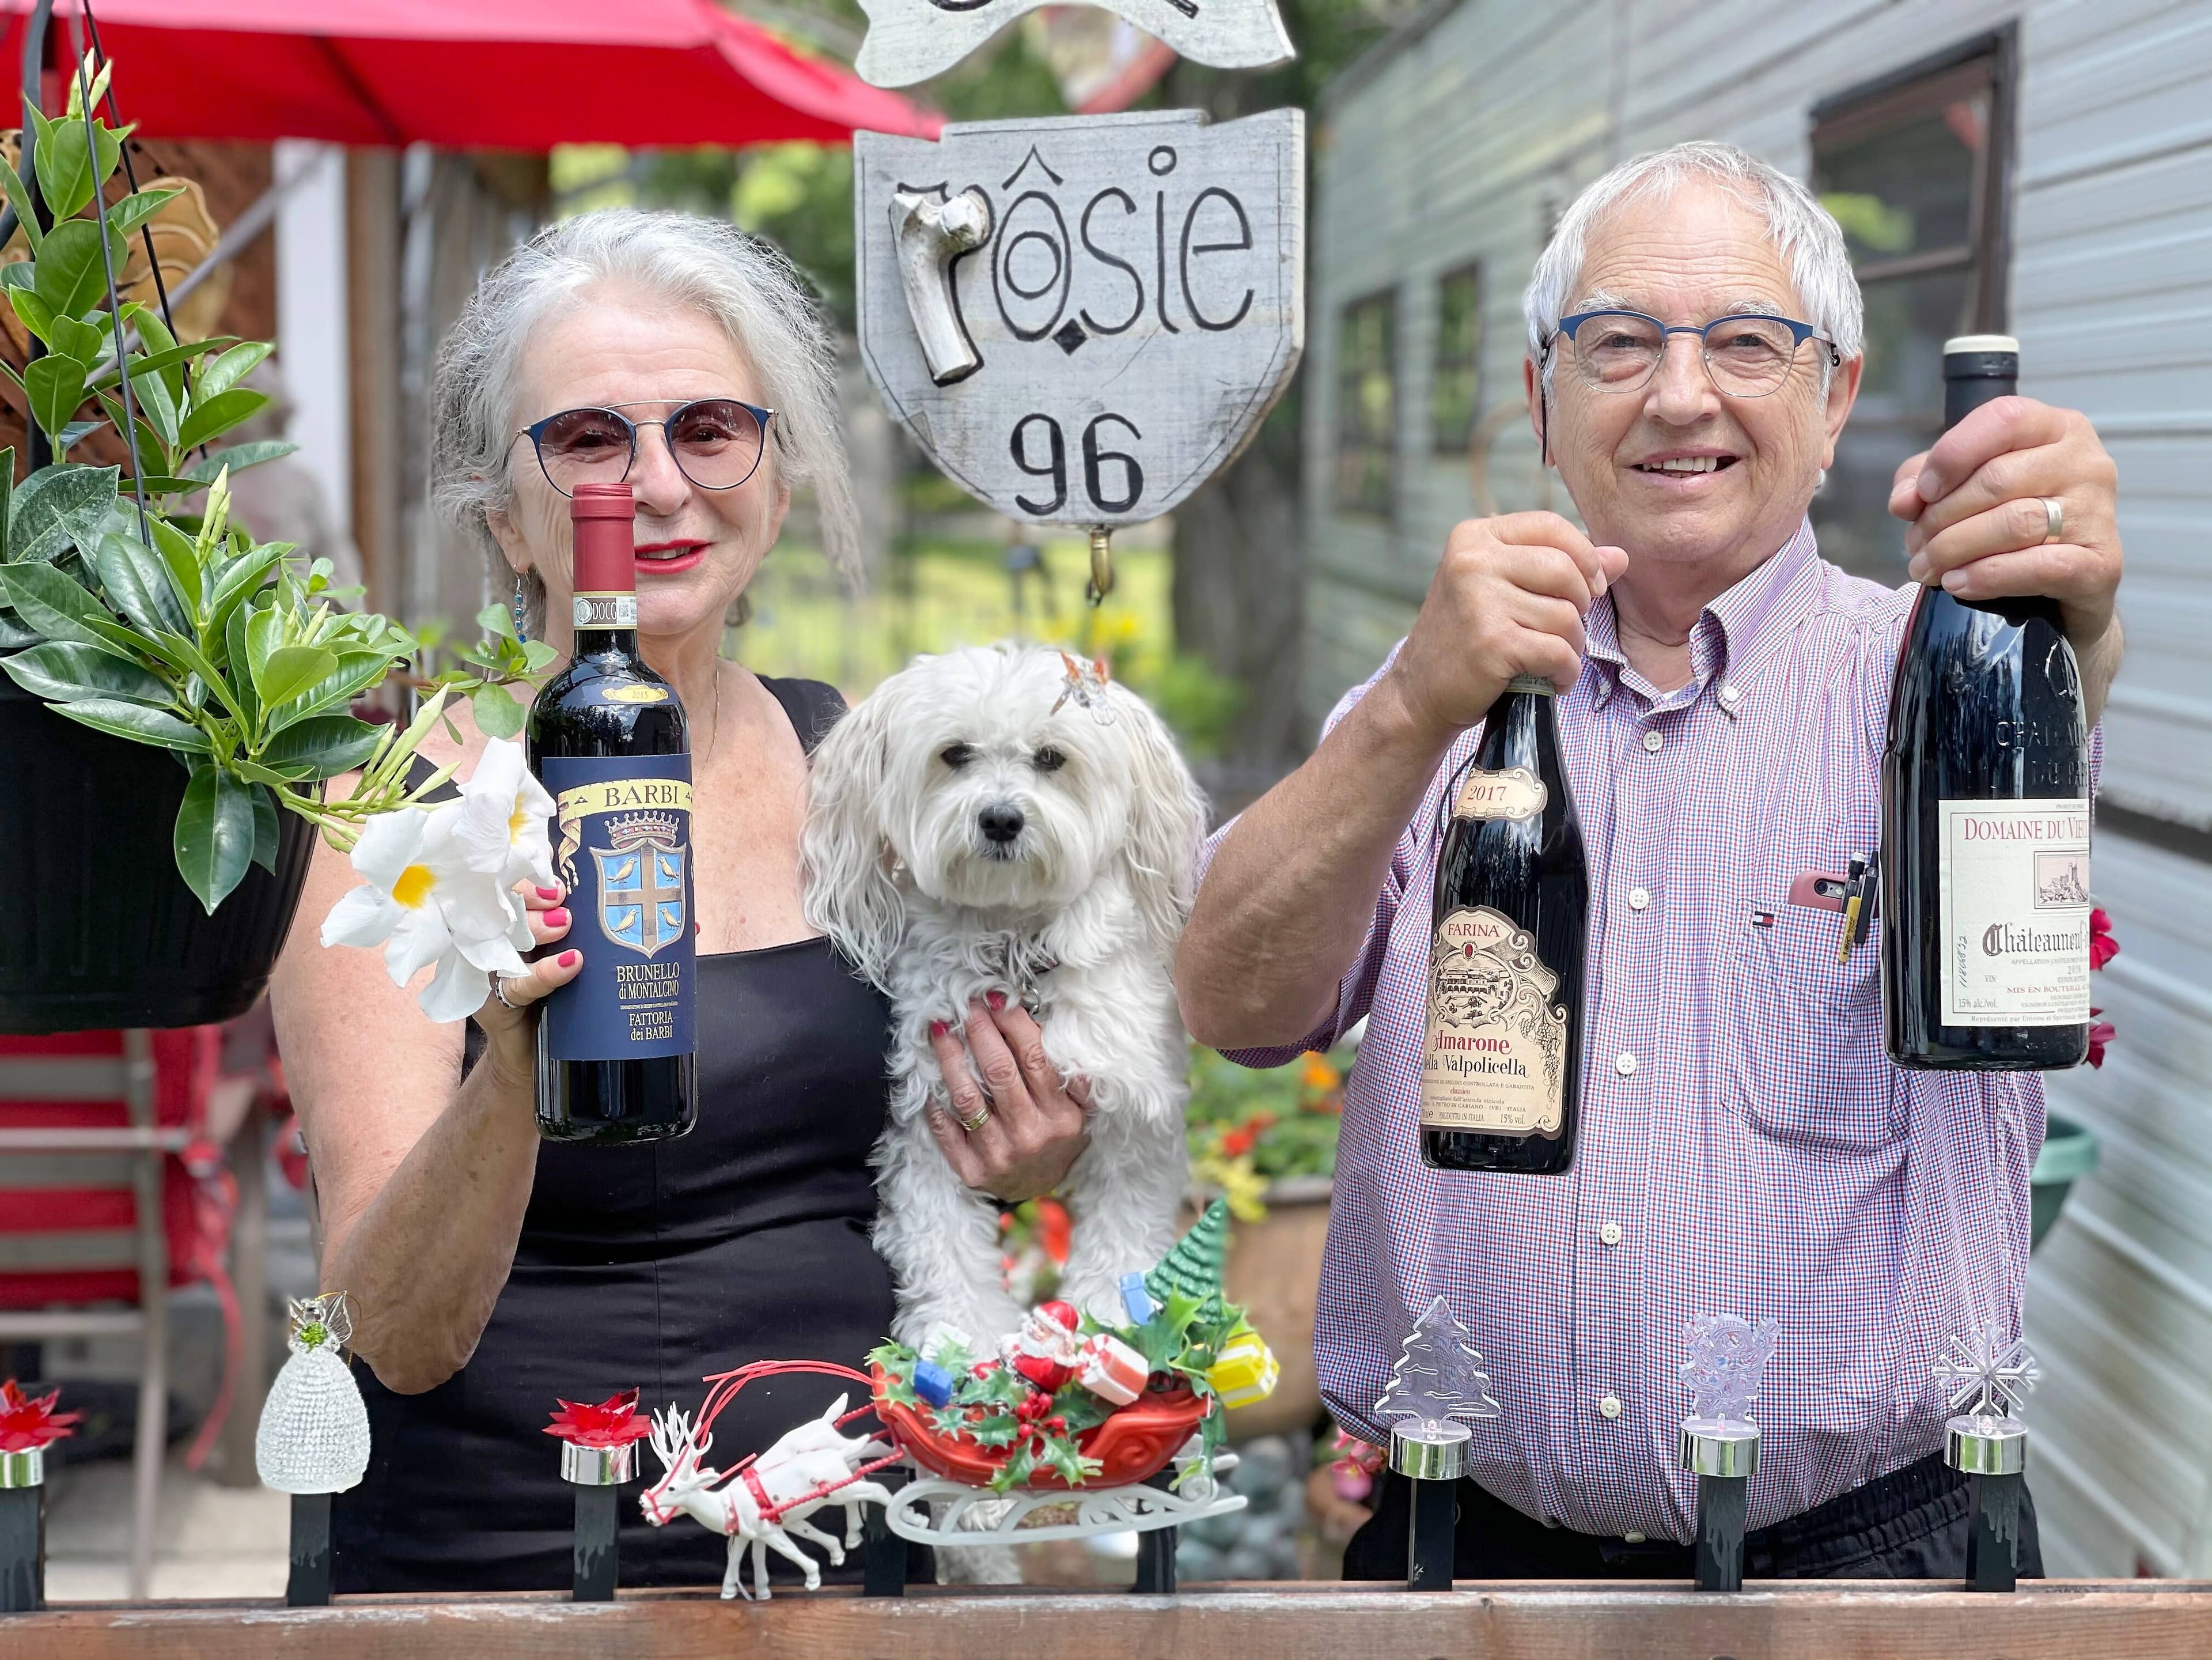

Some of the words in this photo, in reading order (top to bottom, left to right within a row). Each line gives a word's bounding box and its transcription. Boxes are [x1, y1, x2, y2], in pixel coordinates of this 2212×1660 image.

[1009, 412, 1144, 517] 96
[592, 602, 616, 621] DOCG
[632, 691, 648, 699] 2015
[605, 785, 679, 807] BARBI
[1467, 785, 1507, 801] 2017
[1964, 818, 2043, 841] DOMAINE
[2047, 820, 2065, 839] DU
[1448, 923, 1500, 937] FARINA
[616, 962, 680, 982] BRUNELLO
[619, 982, 627, 1000] di
[628, 980, 679, 1000] MONTALCINO
[1959, 999, 1972, 1008] 15%
[628, 1011, 673, 1026] FATTORIA
[1971, 1015, 2008, 1023] Représenté
[630, 1027, 643, 1041] dei
[645, 1025, 673, 1040] BARBI
[1431, 1029, 1512, 1055] Amarone
[1442, 1054, 1530, 1078] Valpolicella
[1450, 1086, 1471, 1095] classico
[1505, 1083, 1535, 1091] GARANTITA
[1439, 1111, 1461, 1121] PRODOTTO
[1461, 1112, 1467, 1121] IN
[1468, 1113, 1484, 1122] ITALIA
[1501, 1113, 1513, 1124] 15%
[1514, 1114, 1526, 1125] vol.
